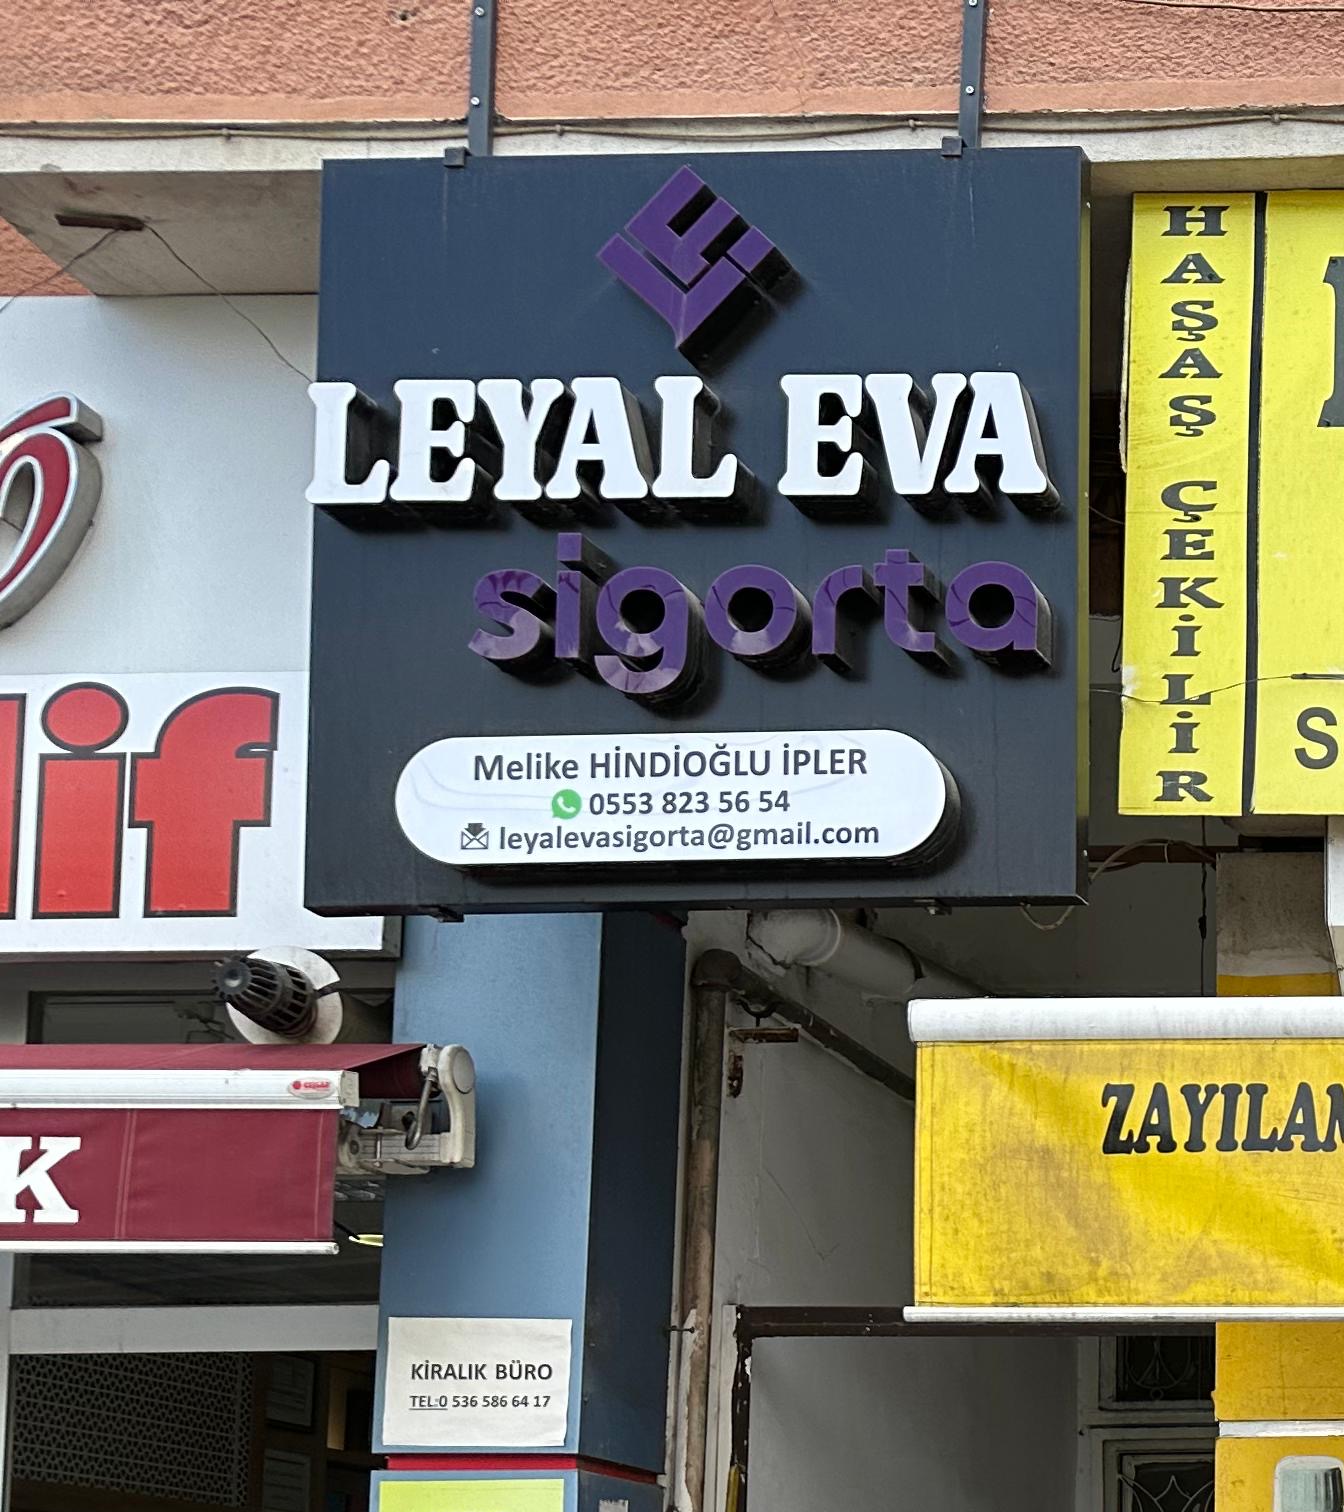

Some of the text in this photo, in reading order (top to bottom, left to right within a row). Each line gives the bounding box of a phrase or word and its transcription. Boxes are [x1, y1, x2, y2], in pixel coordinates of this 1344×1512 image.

[307, 372, 1050, 505] LEYAL EVA
[1154, 205, 1228, 802] HAŞAŞ ÇEKİLİR
[467, 532, 1040, 694] sigorta
[474, 740, 867, 783] Melike HİNDİOĞLU İPLER
[589, 789, 790, 816] 0553 823 56 54
[499, 821, 880, 855] leyalevasigorta@gmail.com
[411, 1359, 553, 1380] KİRALIK BÜRO
[452, 1395, 478, 1408] 536
[482, 1395, 508, 1408] 586
[512, 1395, 529, 1408] 64
[533, 1395, 551, 1408] 17
